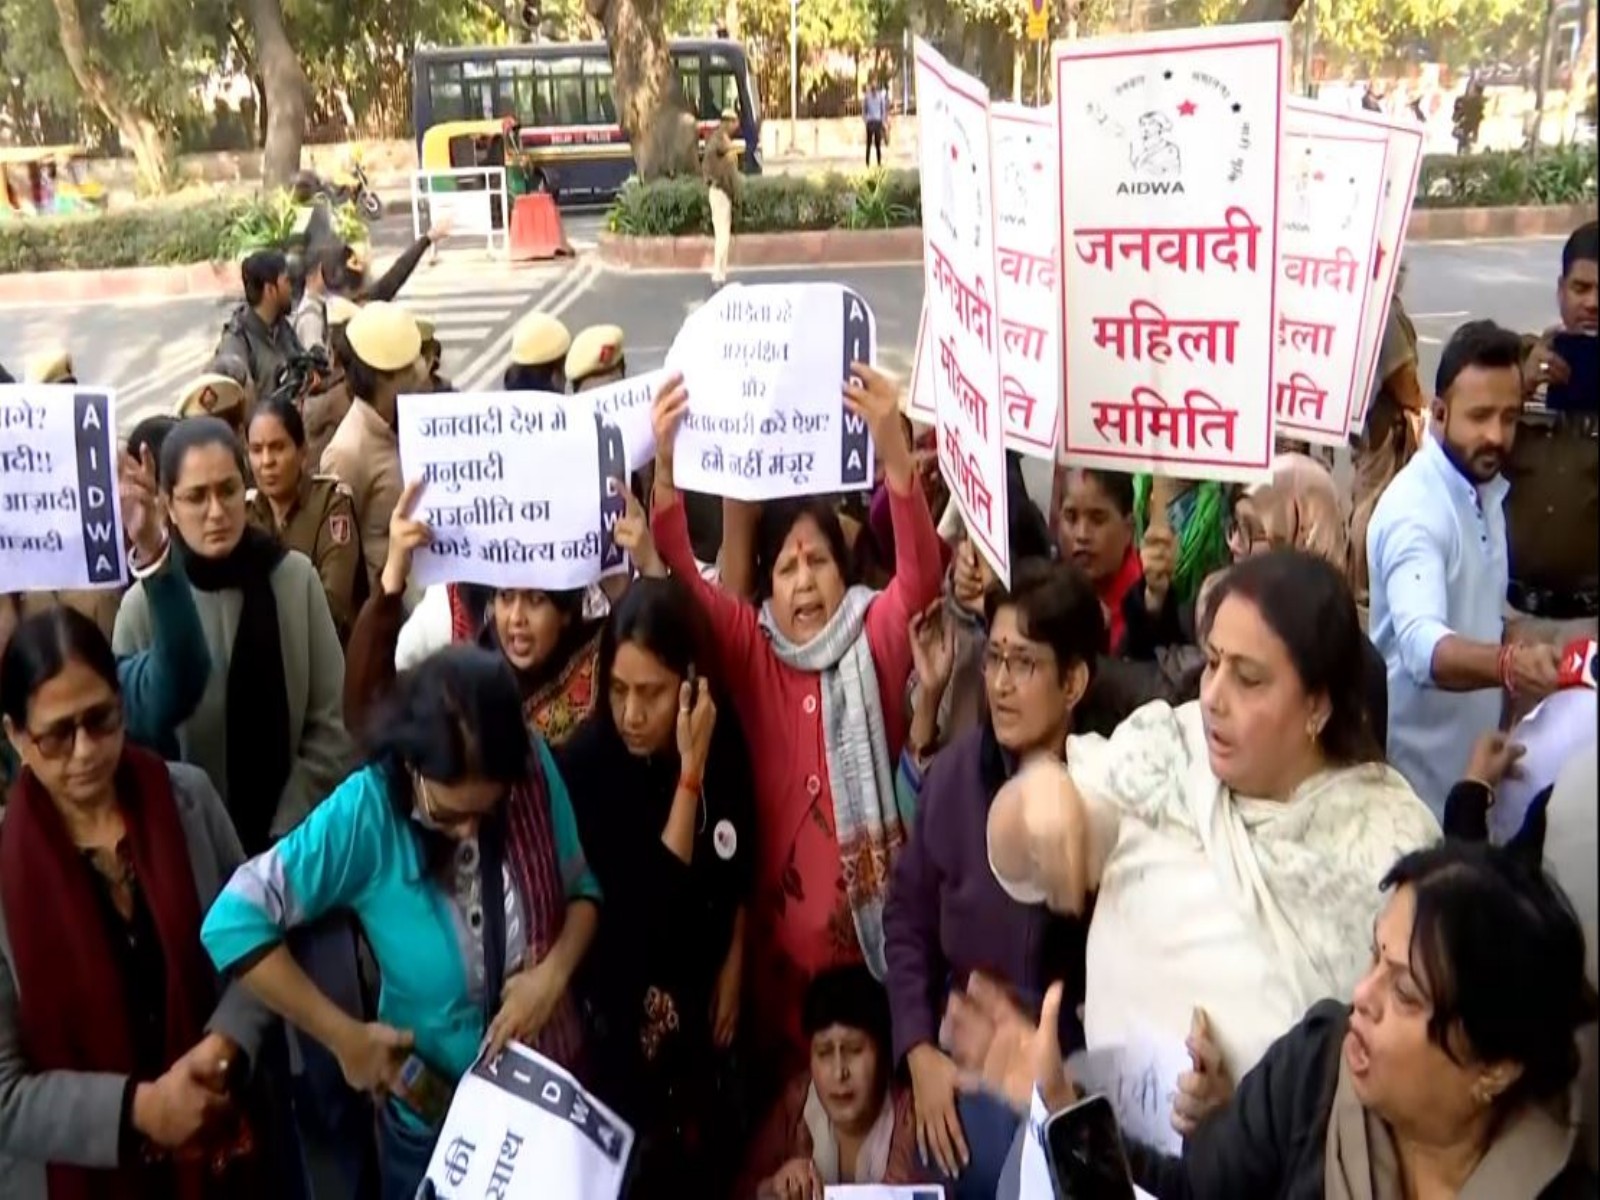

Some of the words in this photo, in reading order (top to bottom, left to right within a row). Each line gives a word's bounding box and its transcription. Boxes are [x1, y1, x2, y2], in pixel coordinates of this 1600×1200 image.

[1116, 181, 1186, 196] AIDWA
[1074, 206, 1262, 272] जनवादी
[1092, 299, 1240, 364] महिला
[419, 404, 503, 438] जनवादी
[1091, 386, 1239, 452] समिति
[82, 403, 112, 572] AIDWA
[421, 450, 504, 492] मनुवादी
[425, 496, 514, 528] राजनीति
[520, 500, 551, 523] का
[444, 1136, 476, 1187] की
